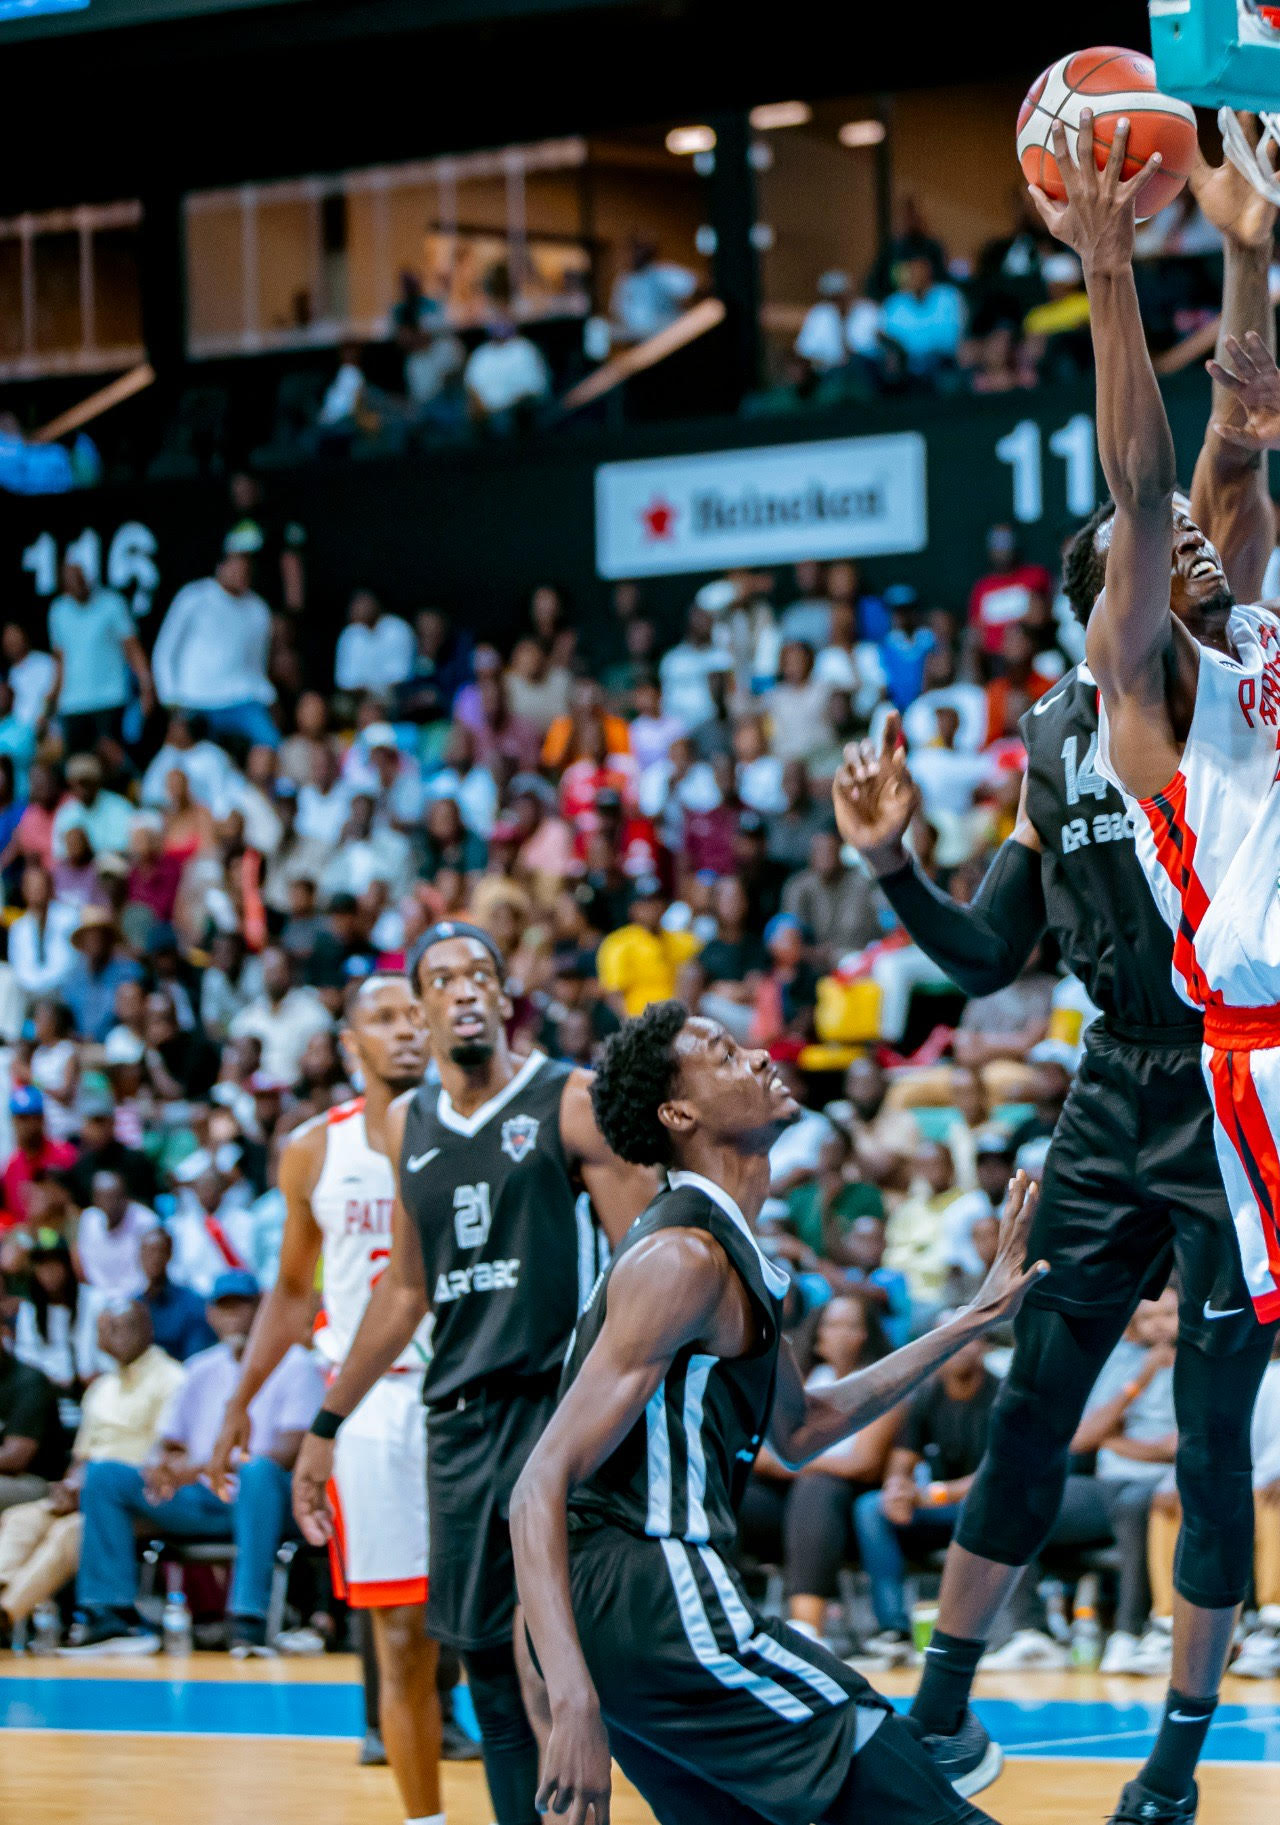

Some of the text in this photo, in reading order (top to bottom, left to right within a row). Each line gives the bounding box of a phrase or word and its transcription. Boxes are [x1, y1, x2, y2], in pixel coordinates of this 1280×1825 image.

[995, 411, 1097, 522] 11
[22, 520, 160, 616] 116
[1061, 730, 1108, 806] 14
[345, 1199, 394, 1235] PAT
[452, 1181, 492, 1250] 21
